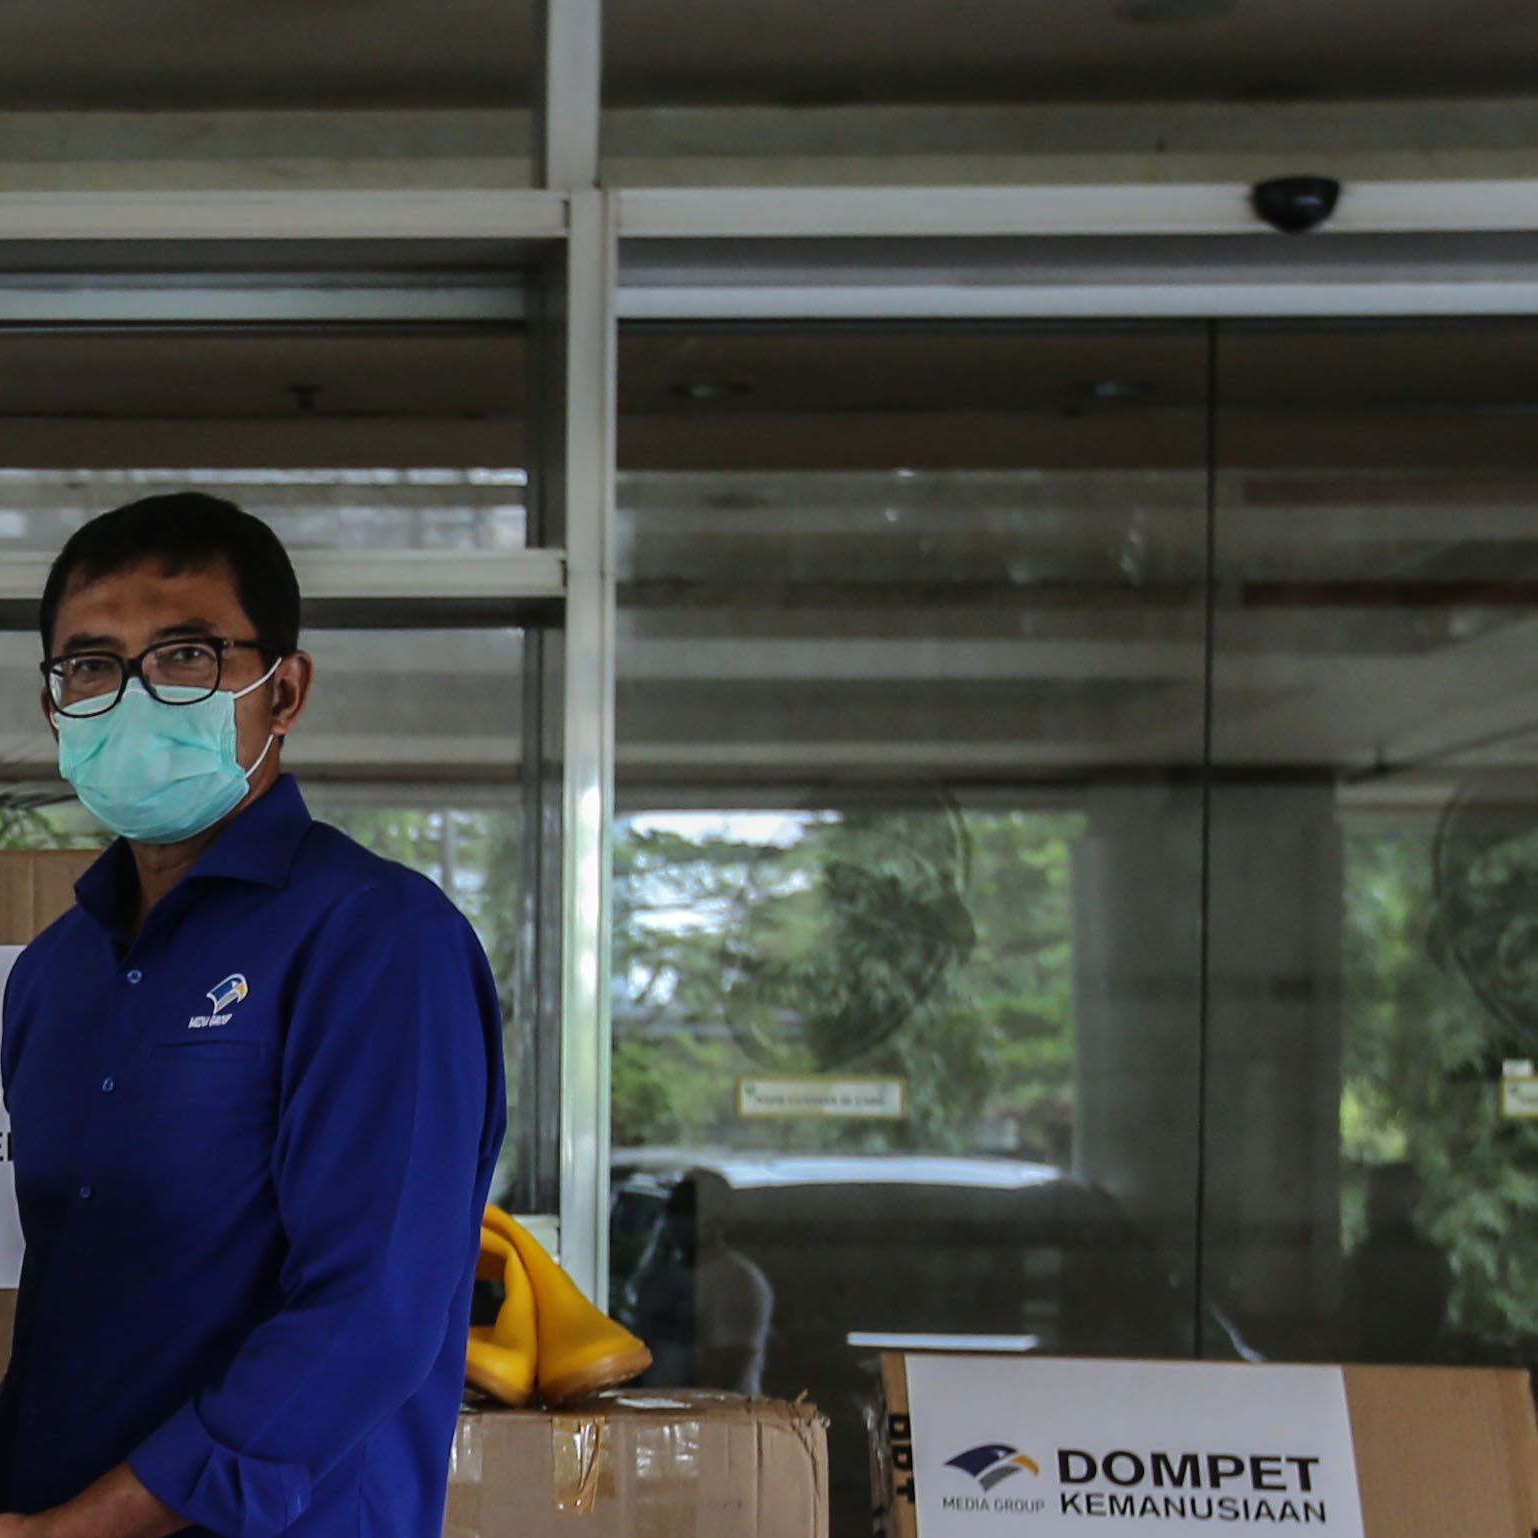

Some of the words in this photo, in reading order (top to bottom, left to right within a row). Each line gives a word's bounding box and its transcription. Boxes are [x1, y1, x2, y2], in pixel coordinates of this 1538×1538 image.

[1058, 1449, 1319, 1492] DOMPET
[943, 1497, 989, 1510] MEDIA
[994, 1499, 1045, 1513] GROUP
[1061, 1493, 1325, 1523] KEMANUSIAAN
